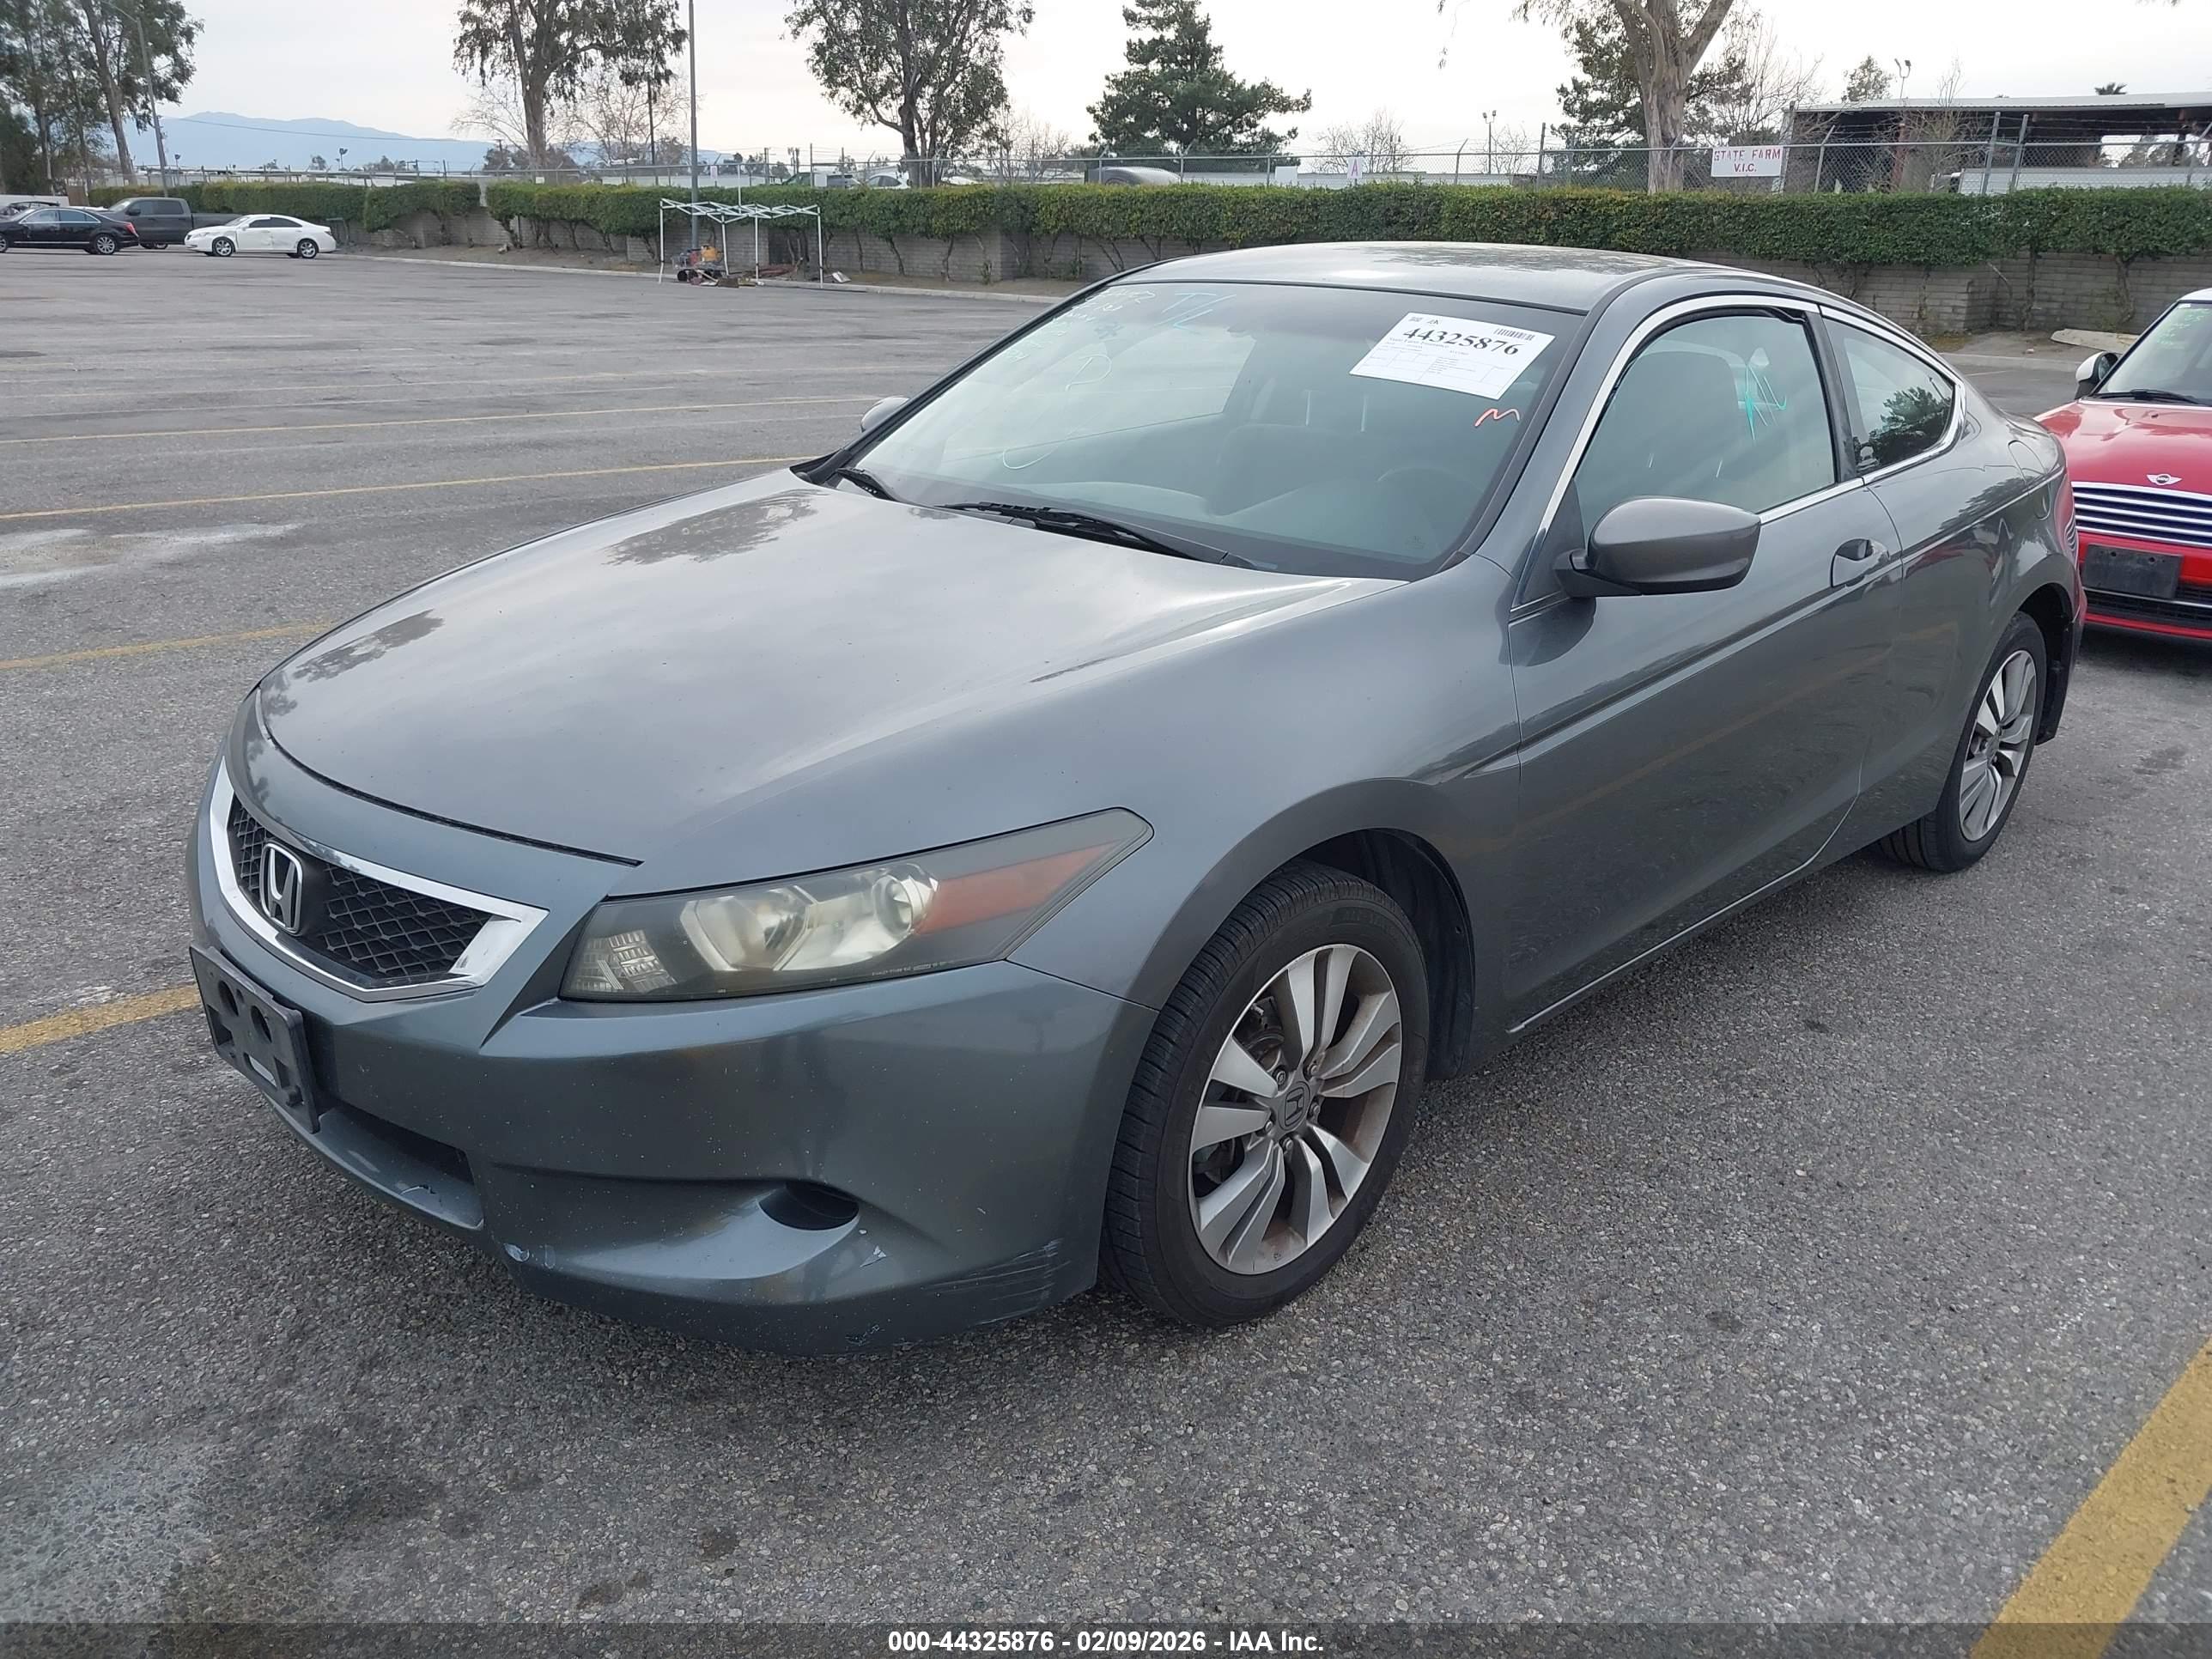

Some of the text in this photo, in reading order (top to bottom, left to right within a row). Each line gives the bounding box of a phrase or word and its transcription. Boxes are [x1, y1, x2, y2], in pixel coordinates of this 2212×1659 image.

[1714, 149, 1781, 161] STATE FARM
[1735, 163, 1757, 173] V.I.C.
[1403, 327, 1525, 356] 44325876
